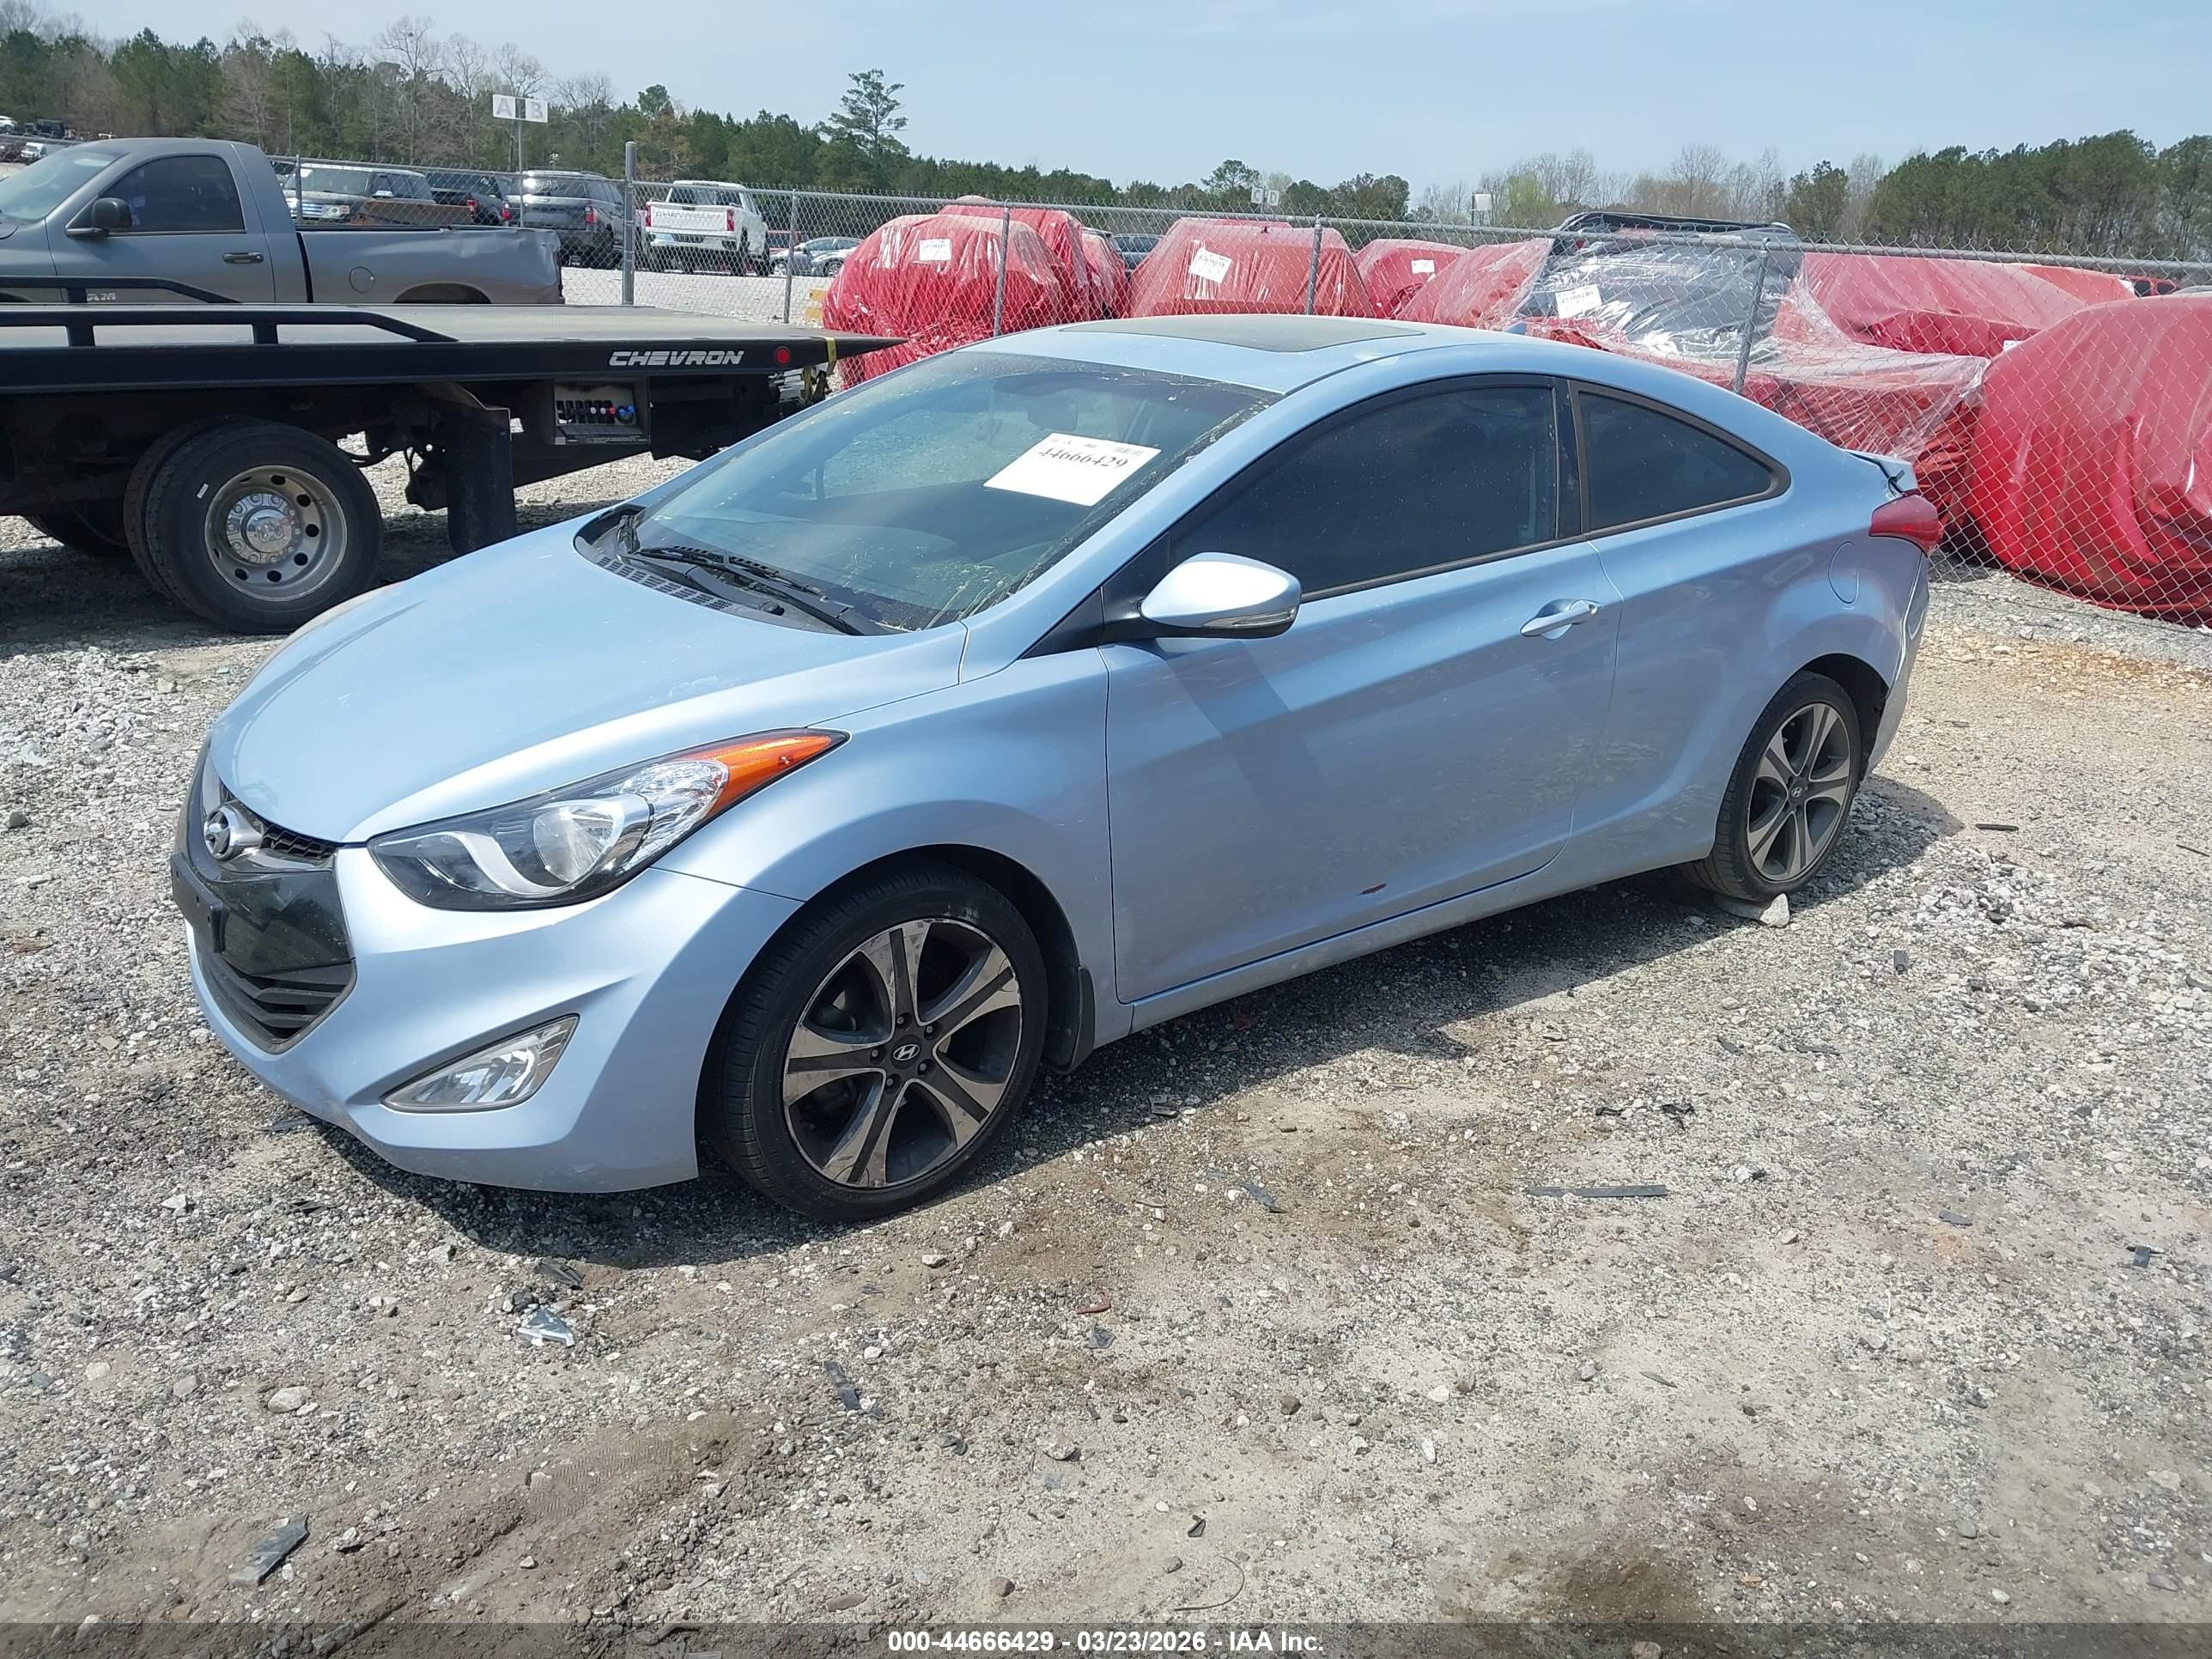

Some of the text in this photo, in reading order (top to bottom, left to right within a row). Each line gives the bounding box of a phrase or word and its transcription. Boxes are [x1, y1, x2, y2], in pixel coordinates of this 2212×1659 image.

[496, 97, 544, 118] A B
[609, 350, 744, 366] CHEVRON
[1038, 447, 1129, 468] 44666429
